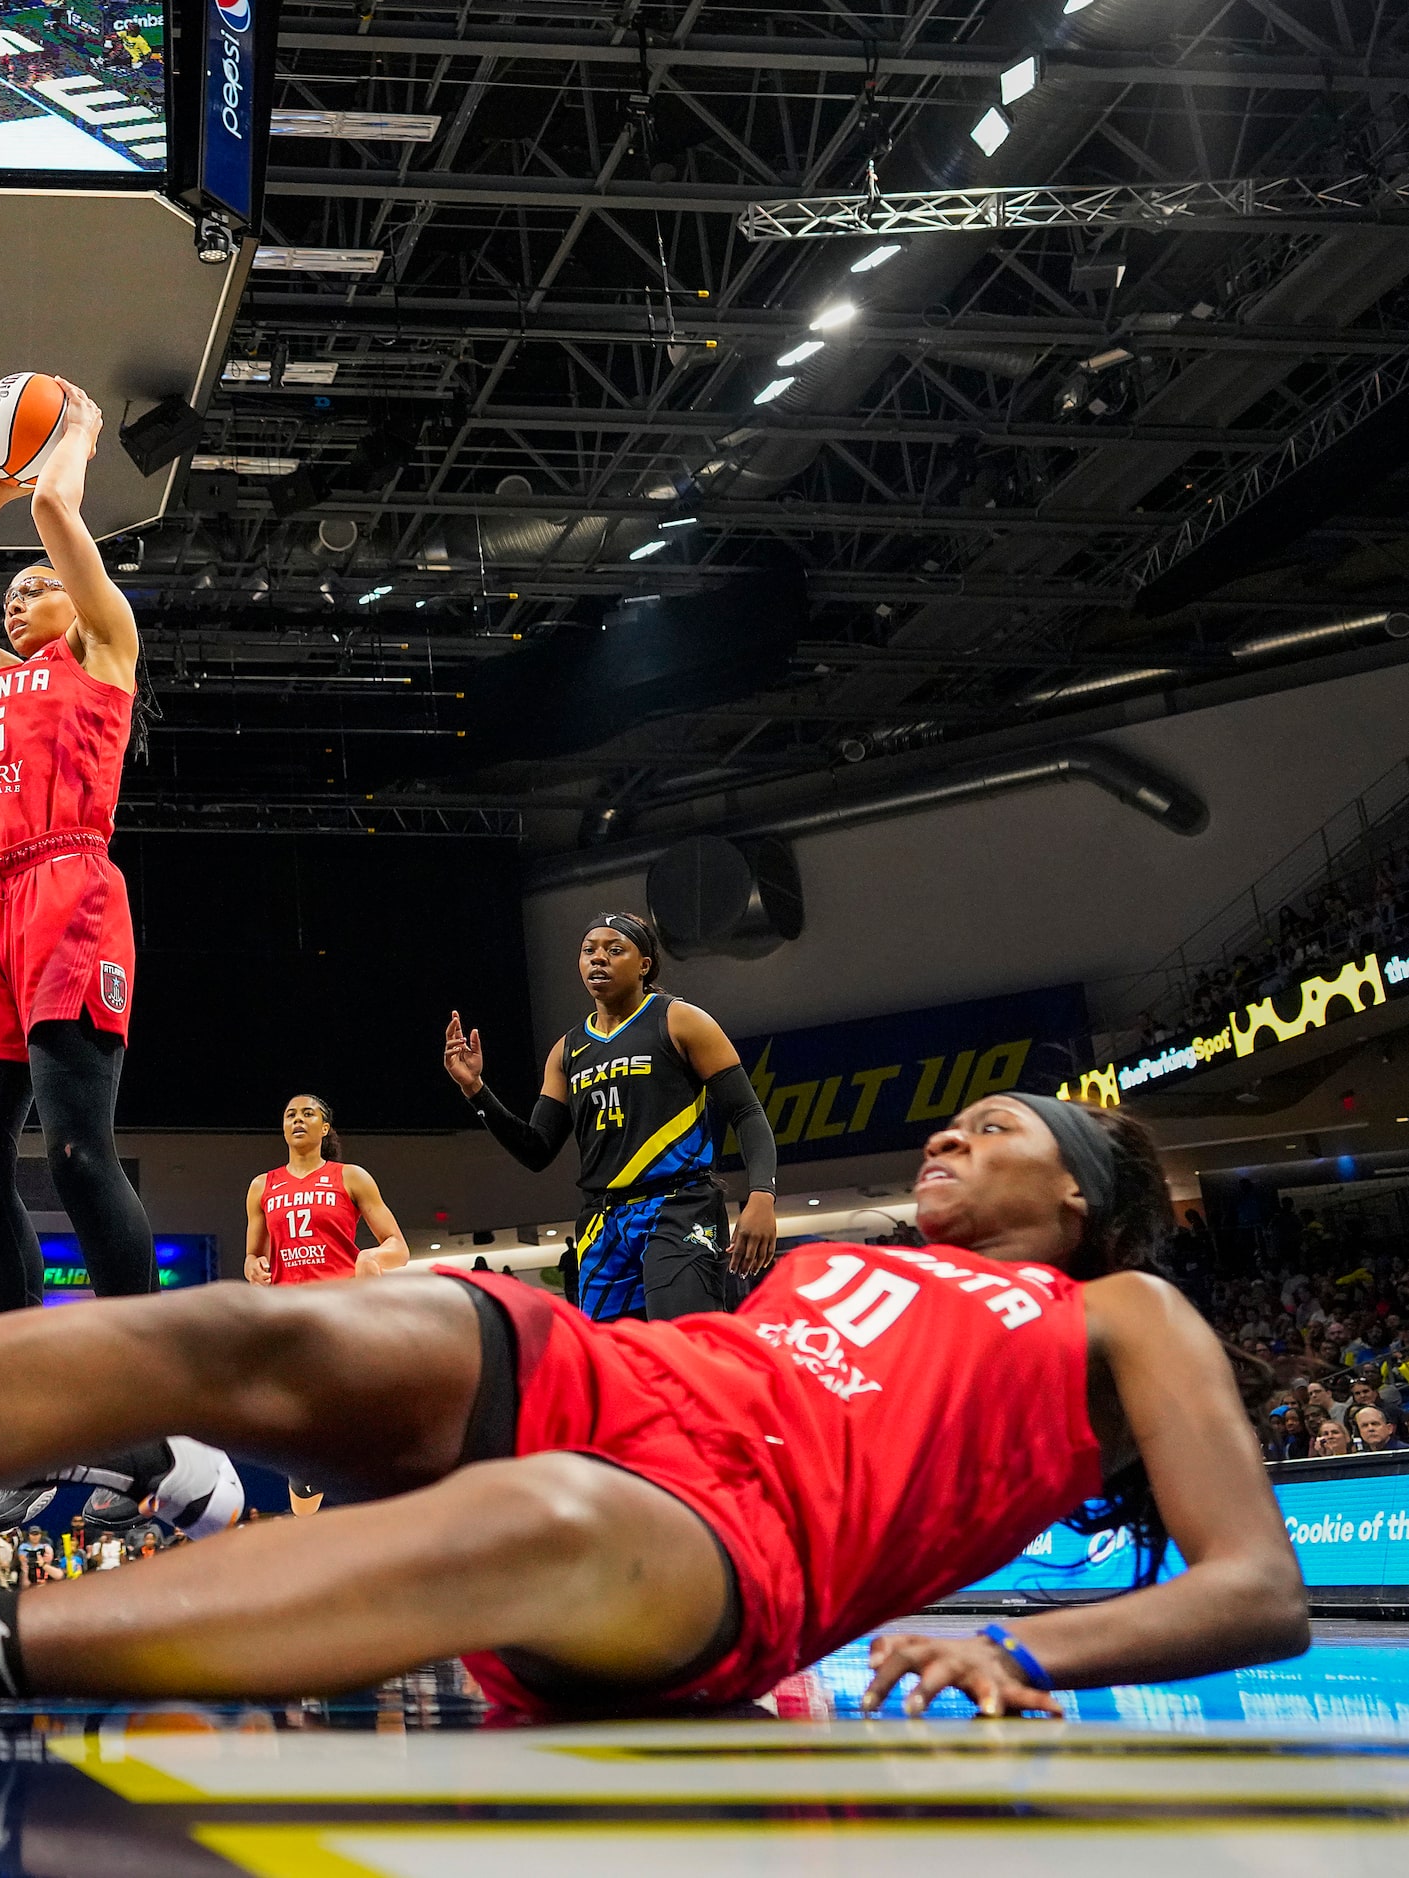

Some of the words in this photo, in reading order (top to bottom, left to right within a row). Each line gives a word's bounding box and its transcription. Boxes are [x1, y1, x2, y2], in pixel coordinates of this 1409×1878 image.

[222, 29, 241, 140] pepsi
[1384, 955, 1409, 984] th
[570, 1055, 652, 1095] TEXAS
[1118, 1026, 1233, 1090] theParkingSpot
[904, 1038, 1032, 1123] UP
[591, 1086, 625, 1131] 24
[266, 1191, 336, 1213] ATLANTA
[285, 1208, 313, 1239] 12
[280, 1245, 327, 1262] EMORY
[44, 1267, 91, 1285] FLIG
[796, 1254, 921, 1348] 10
[1285, 1513, 1355, 1545] Cookie
[1358, 1511, 1385, 1542] of
